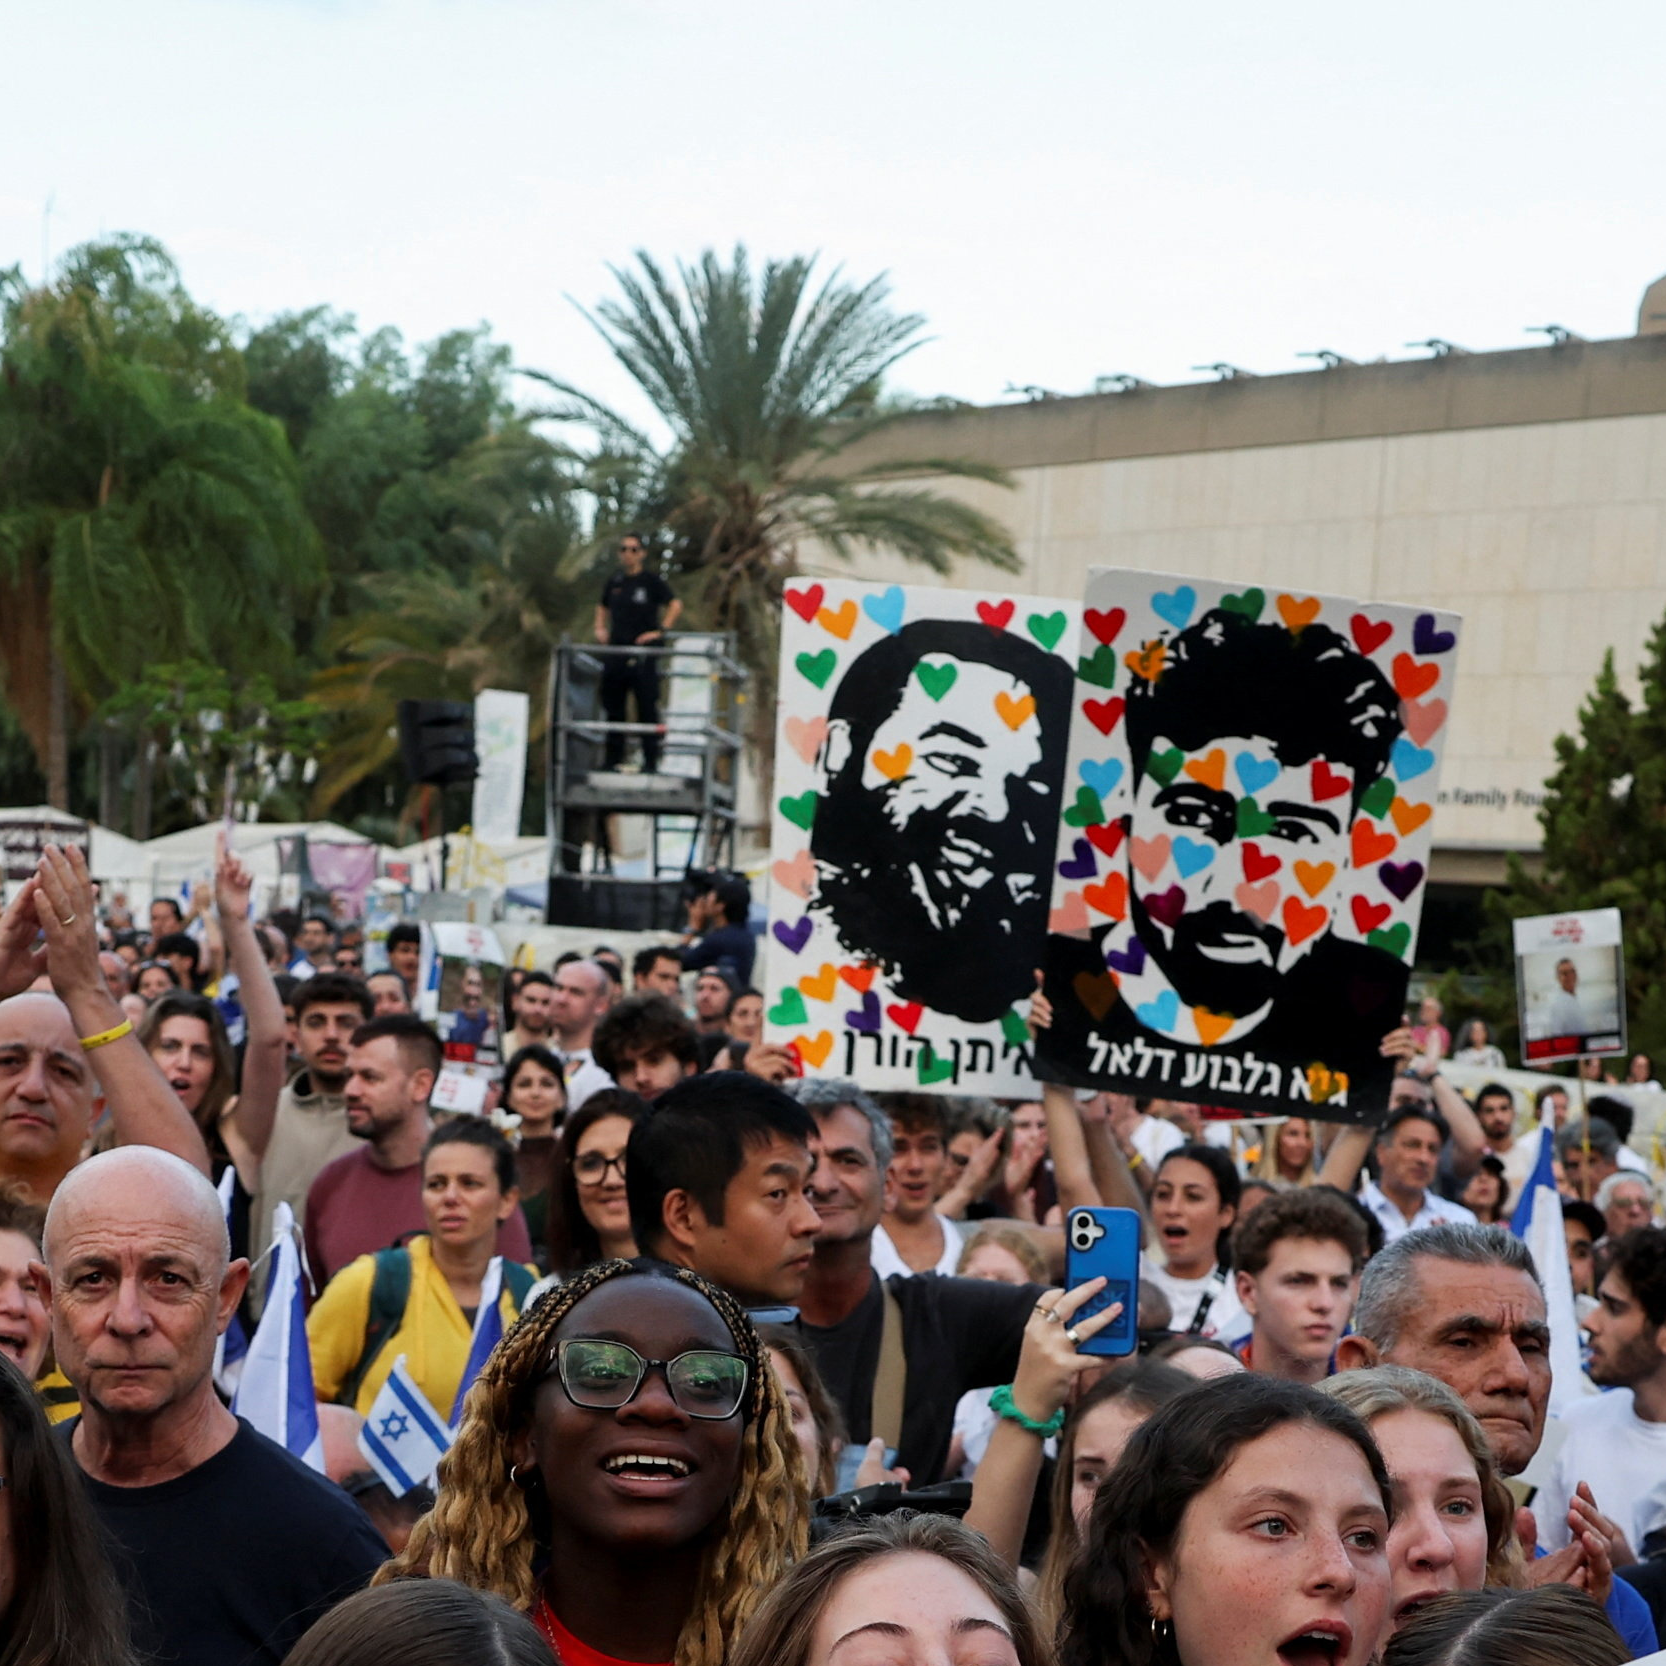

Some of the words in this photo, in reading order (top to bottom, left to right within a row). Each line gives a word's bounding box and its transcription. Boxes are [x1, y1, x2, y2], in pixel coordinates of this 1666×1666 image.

[844, 1028, 933, 1081] הורן
[950, 1036, 1034, 1085] איתן
[1087, 1032, 1176, 1083] דלאל
[1181, 1052, 1281, 1098] גלבוע
